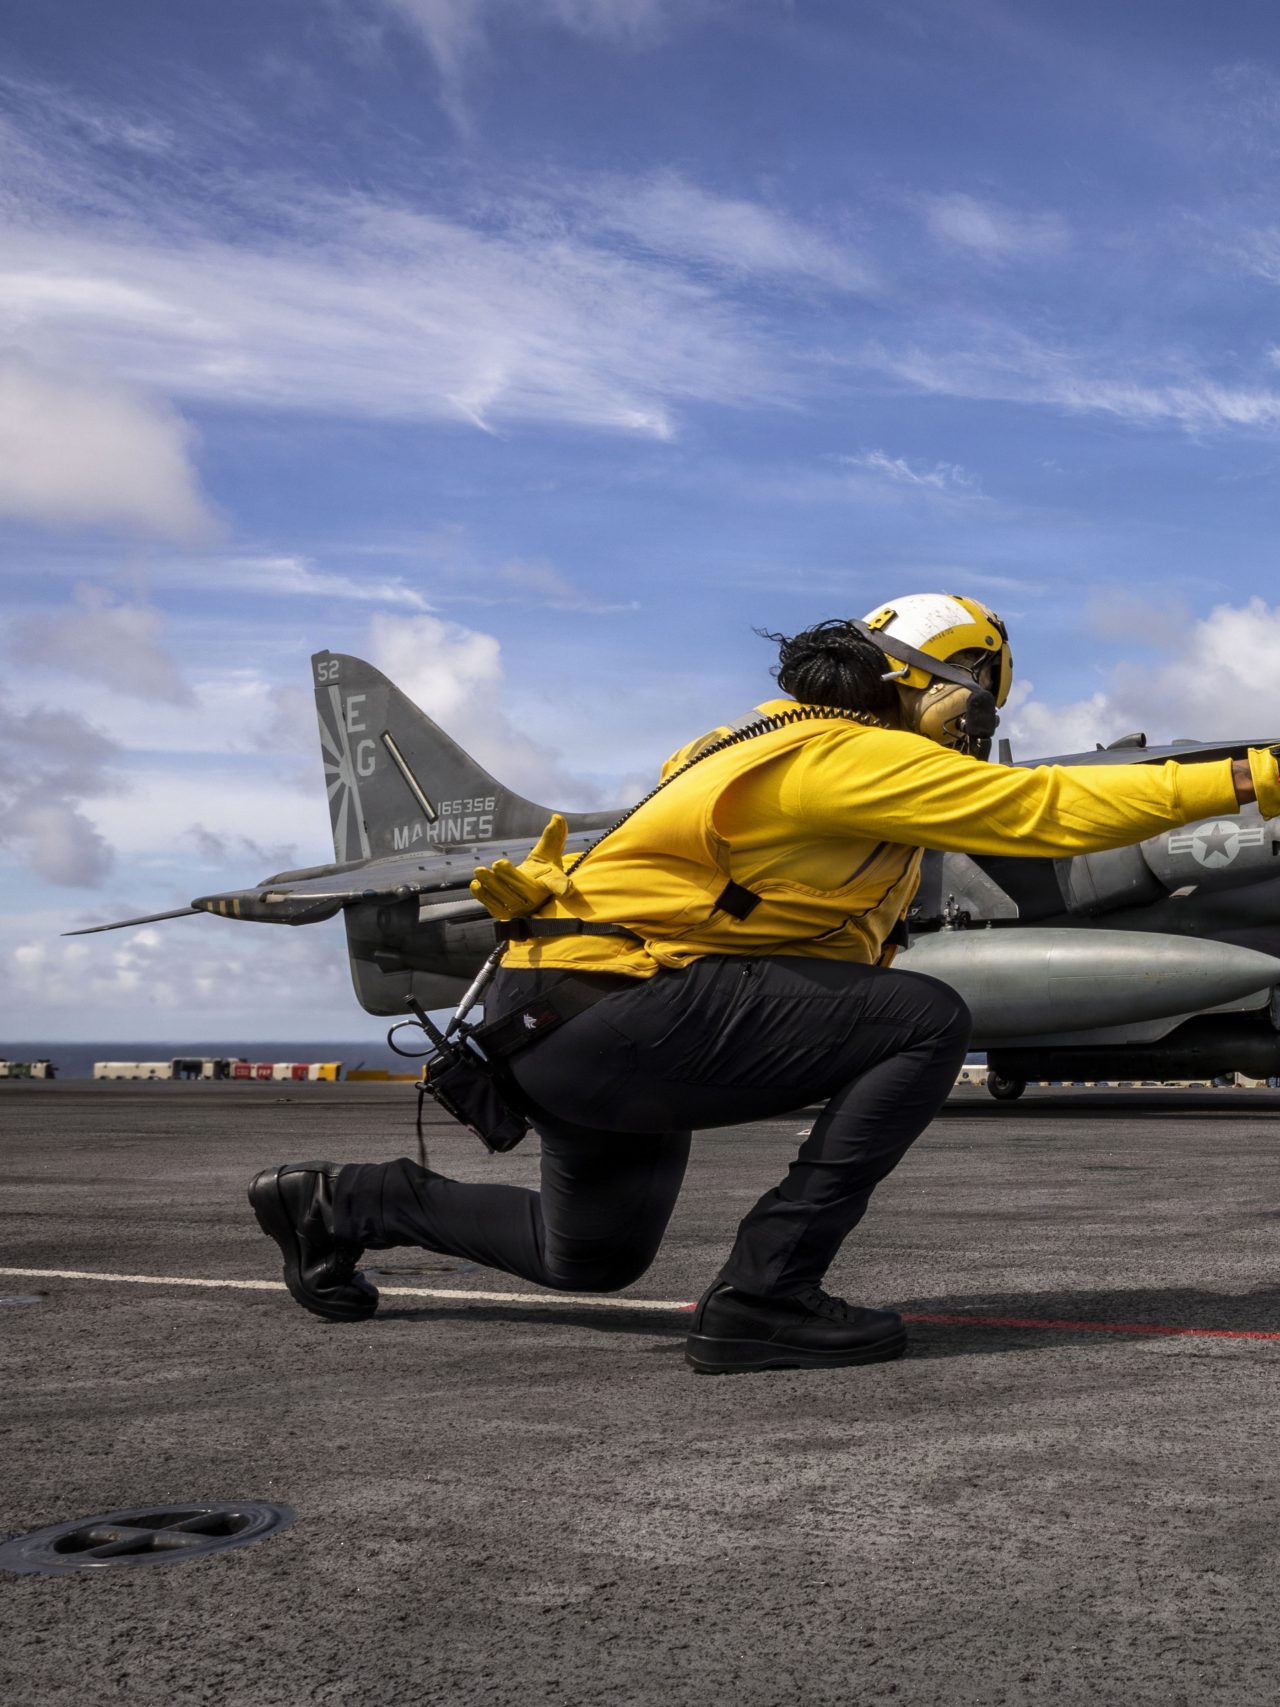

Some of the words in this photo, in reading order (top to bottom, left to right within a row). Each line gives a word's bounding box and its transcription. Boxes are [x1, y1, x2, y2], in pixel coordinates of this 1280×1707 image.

[317, 660, 340, 681] 52
[346, 694, 366, 733] E
[357, 739, 376, 777] G
[437, 797, 496, 816] 165356
[393, 815, 494, 850] MARINES
